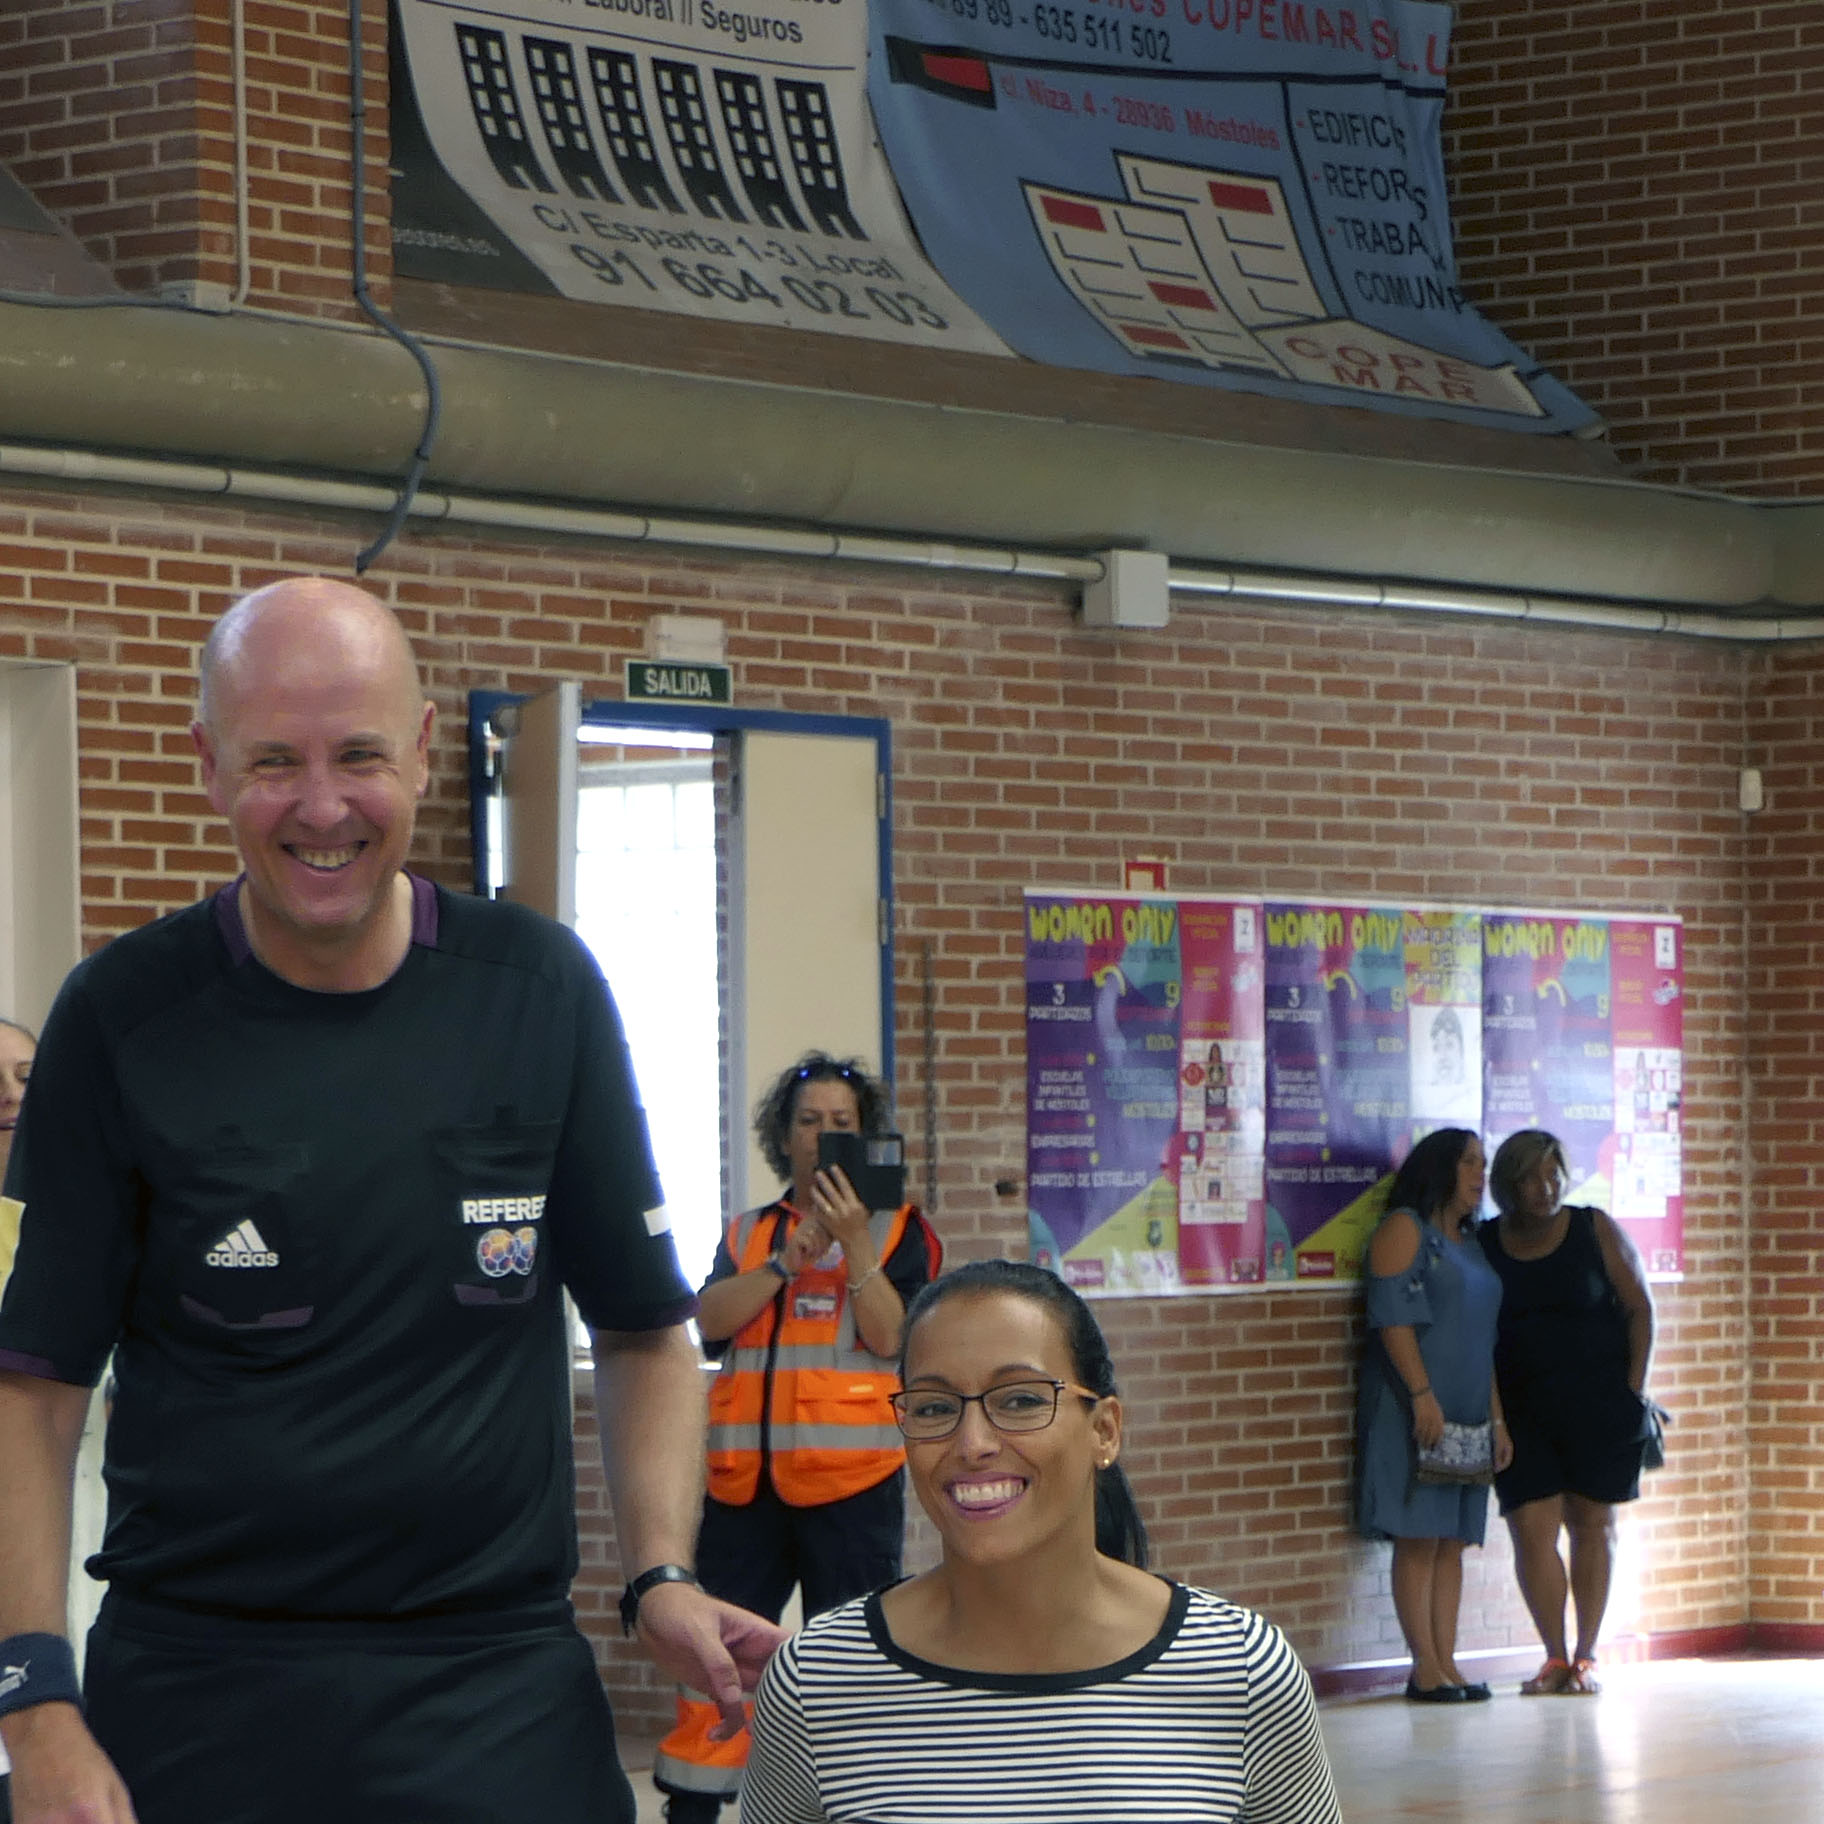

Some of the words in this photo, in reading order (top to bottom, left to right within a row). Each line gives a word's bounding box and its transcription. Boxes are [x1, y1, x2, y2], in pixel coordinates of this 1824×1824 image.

[702, 1, 803, 43] Seguros
[1034, 4, 1077, 43] 635
[1084, 13, 1123, 52] 511
[1131, 25, 1172, 63] 502
[581, 211, 735, 258] Esparta
[736, 235, 797, 268] 1-3
[796, 245, 905, 282] Local
[570, 243, 657, 292] 91
[661, 256, 782, 309] 664
[781, 275, 871, 320] 02
[866, 286, 949, 331] 03
[1284, 336, 1468, 379] COPE
[1332, 364, 1480, 403] MAR
[645, 667, 713, 698] SALIDA
[1052, 983, 1065, 1005] 3
[1288, 986, 1300, 1008] 3
[462, 1195, 547, 1224] REFERE
[206, 1243, 280, 1267] adidas
